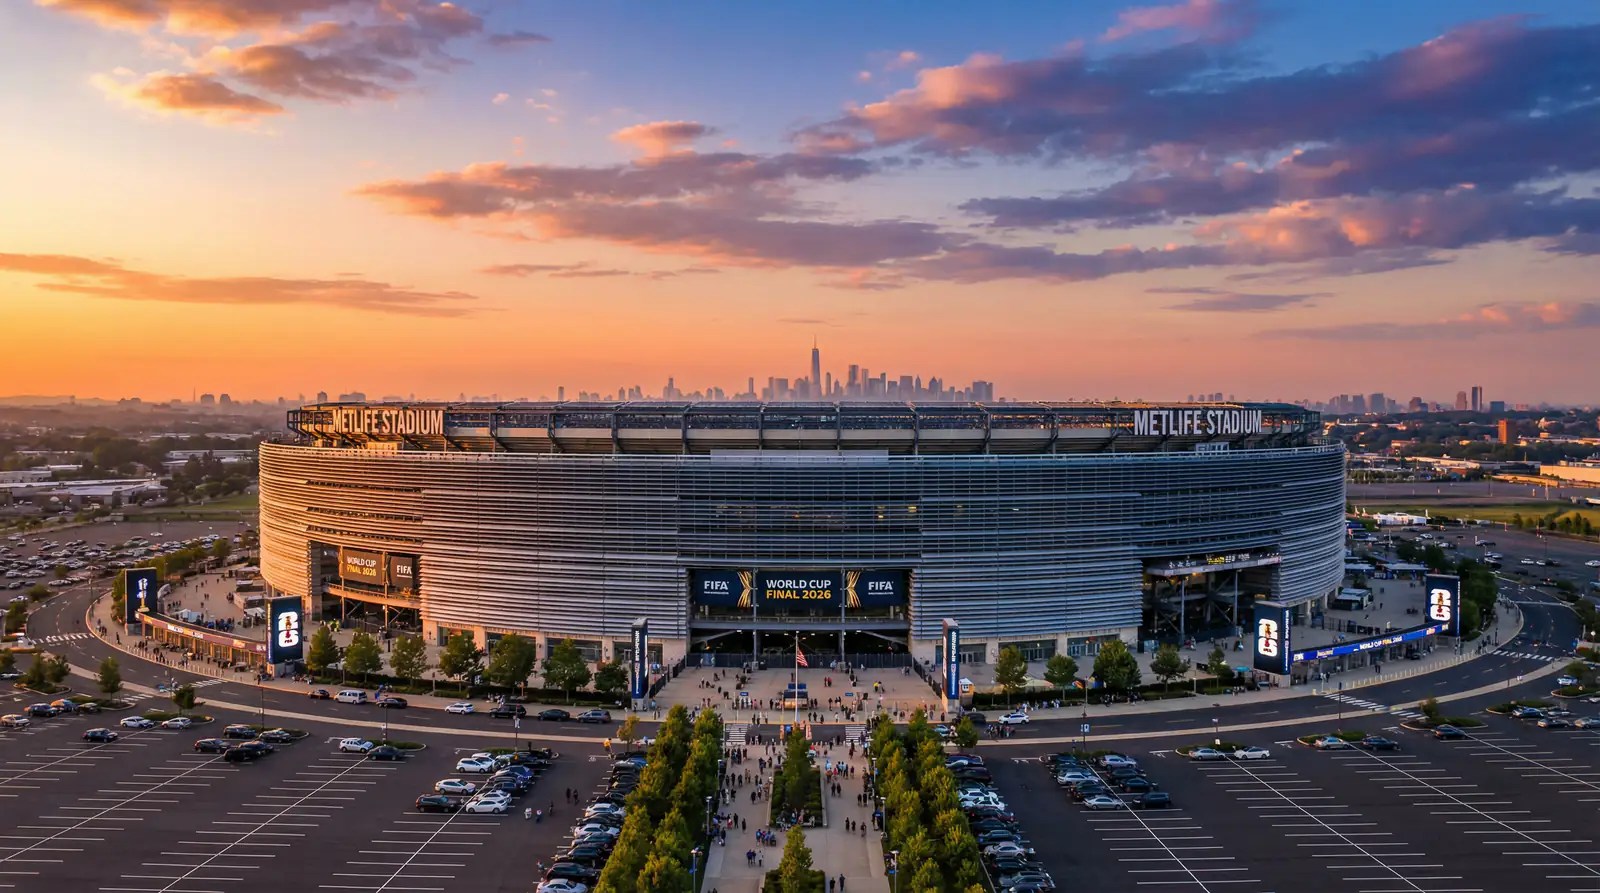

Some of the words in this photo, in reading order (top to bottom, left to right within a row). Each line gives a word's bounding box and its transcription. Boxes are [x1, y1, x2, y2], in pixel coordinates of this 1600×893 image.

[332, 410, 379, 434] METLIFE
[382, 409, 444, 435] STADIUM
[1134, 410, 1203, 436] METLIFE
[1206, 410, 1262, 435] STADIUM
[396, 565, 412, 574] FIFA
[703, 580, 729, 591] FIFA
[766, 579, 807, 589] WORLD
[808, 579, 832, 589] CUP
[868, 581, 894, 591] FIFA
[766, 589, 800, 600] FINAL
[802, 589, 832, 600] 2026
